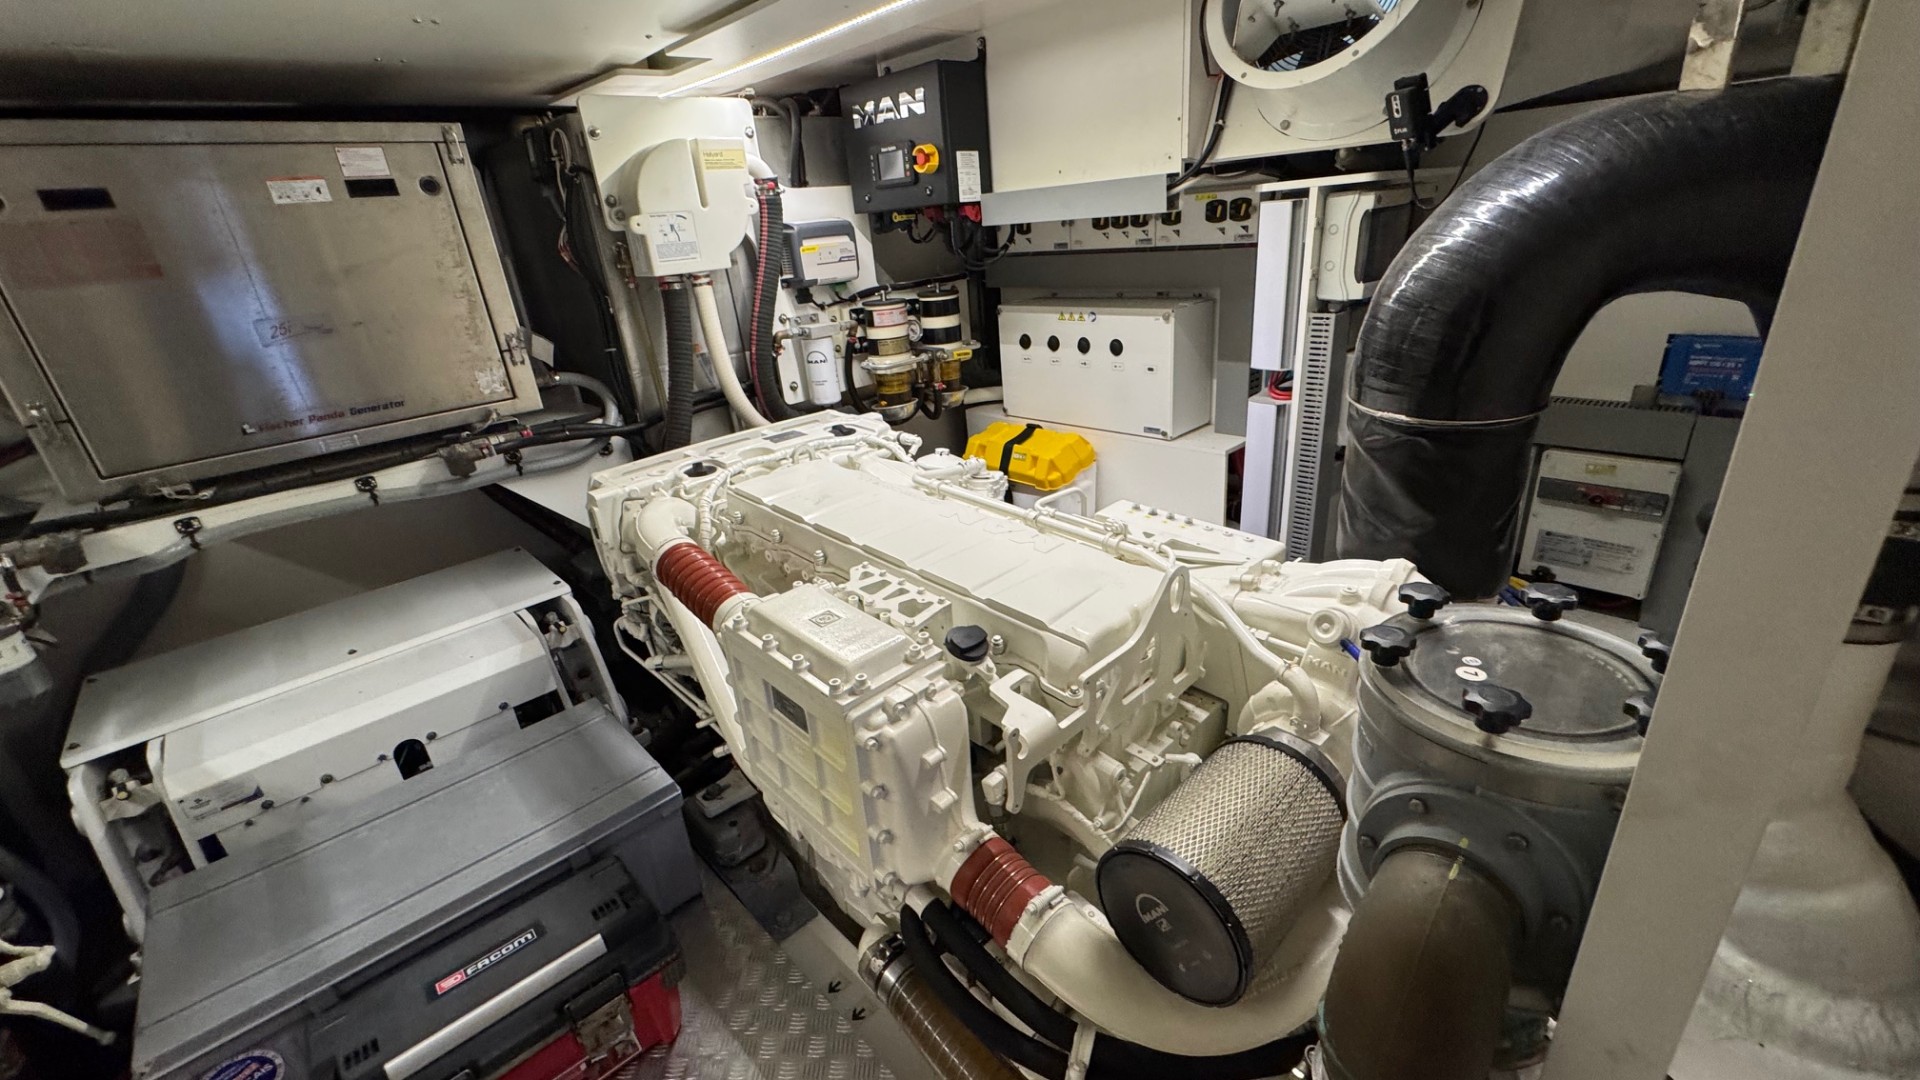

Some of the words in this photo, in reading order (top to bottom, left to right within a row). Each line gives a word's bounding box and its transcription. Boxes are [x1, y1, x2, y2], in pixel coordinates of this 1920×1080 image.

[852, 87, 926, 129] MAN
[308, 410, 345, 425] Panda
[350, 400, 405, 416] Generator
[1142, 905, 1167, 923] MAN
[466, 932, 534, 976] FACOM
